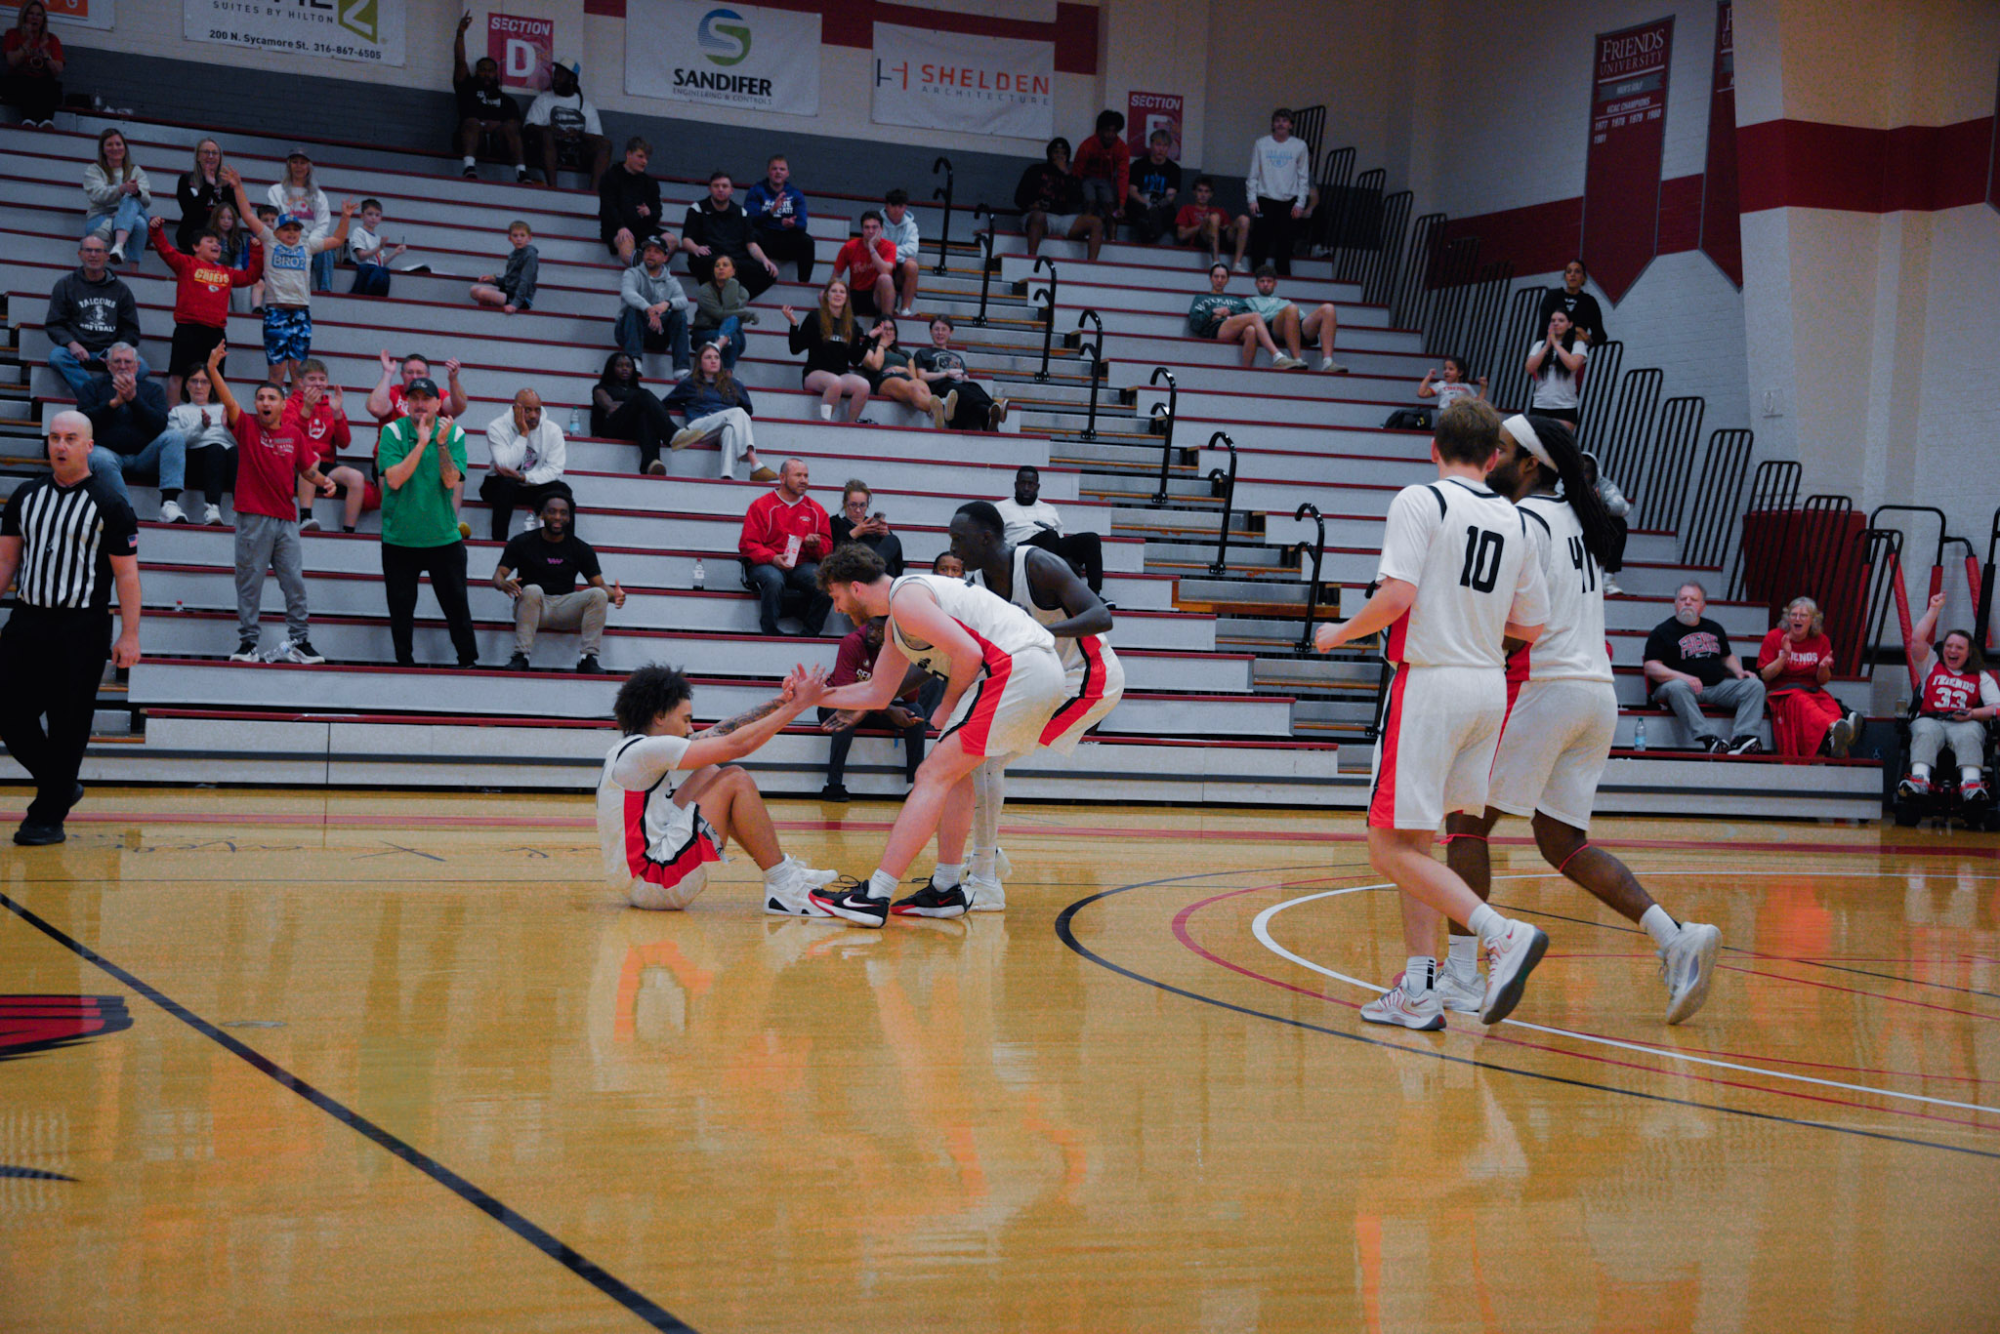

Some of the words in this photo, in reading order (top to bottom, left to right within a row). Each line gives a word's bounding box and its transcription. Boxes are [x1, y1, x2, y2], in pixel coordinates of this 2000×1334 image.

[213, 1, 260, 14] SUITES
[266, 8, 282, 17] BY
[288, 11, 334, 24] HILTON
[490, 17, 551, 36] SECTION
[209, 29, 228, 40] 200
[230, 32, 241, 42] N.
[243, 34, 294, 49] Sycamore
[295, 40, 309, 51] St.
[313, 43, 382, 60] 316-867-6505
[1601, 28, 1665, 63] FRIENDS
[506, 38, 536, 78] D
[1600, 50, 1663, 75] UNIVERSITY
[673, 68, 772, 97] SANDIFER
[921, 64, 1049, 95] SHELDEN
[673, 87, 723, 100] ENGINEERING
[732, 95, 772, 106] CONTROLS
[922, 86, 1049, 106] ARCHITECTURE
[1130, 95, 1181, 110] SECTION
[273, 255, 306, 268] BRO?
[194, 268, 230, 284] CHIEFS
[79, 297, 116, 308] FALCONS
[1459, 525, 1505, 594] 10
[1568, 536, 1595, 594] 41
[1932, 674, 1976, 694] FRIENDS
[1934, 687, 1968, 709] 33
